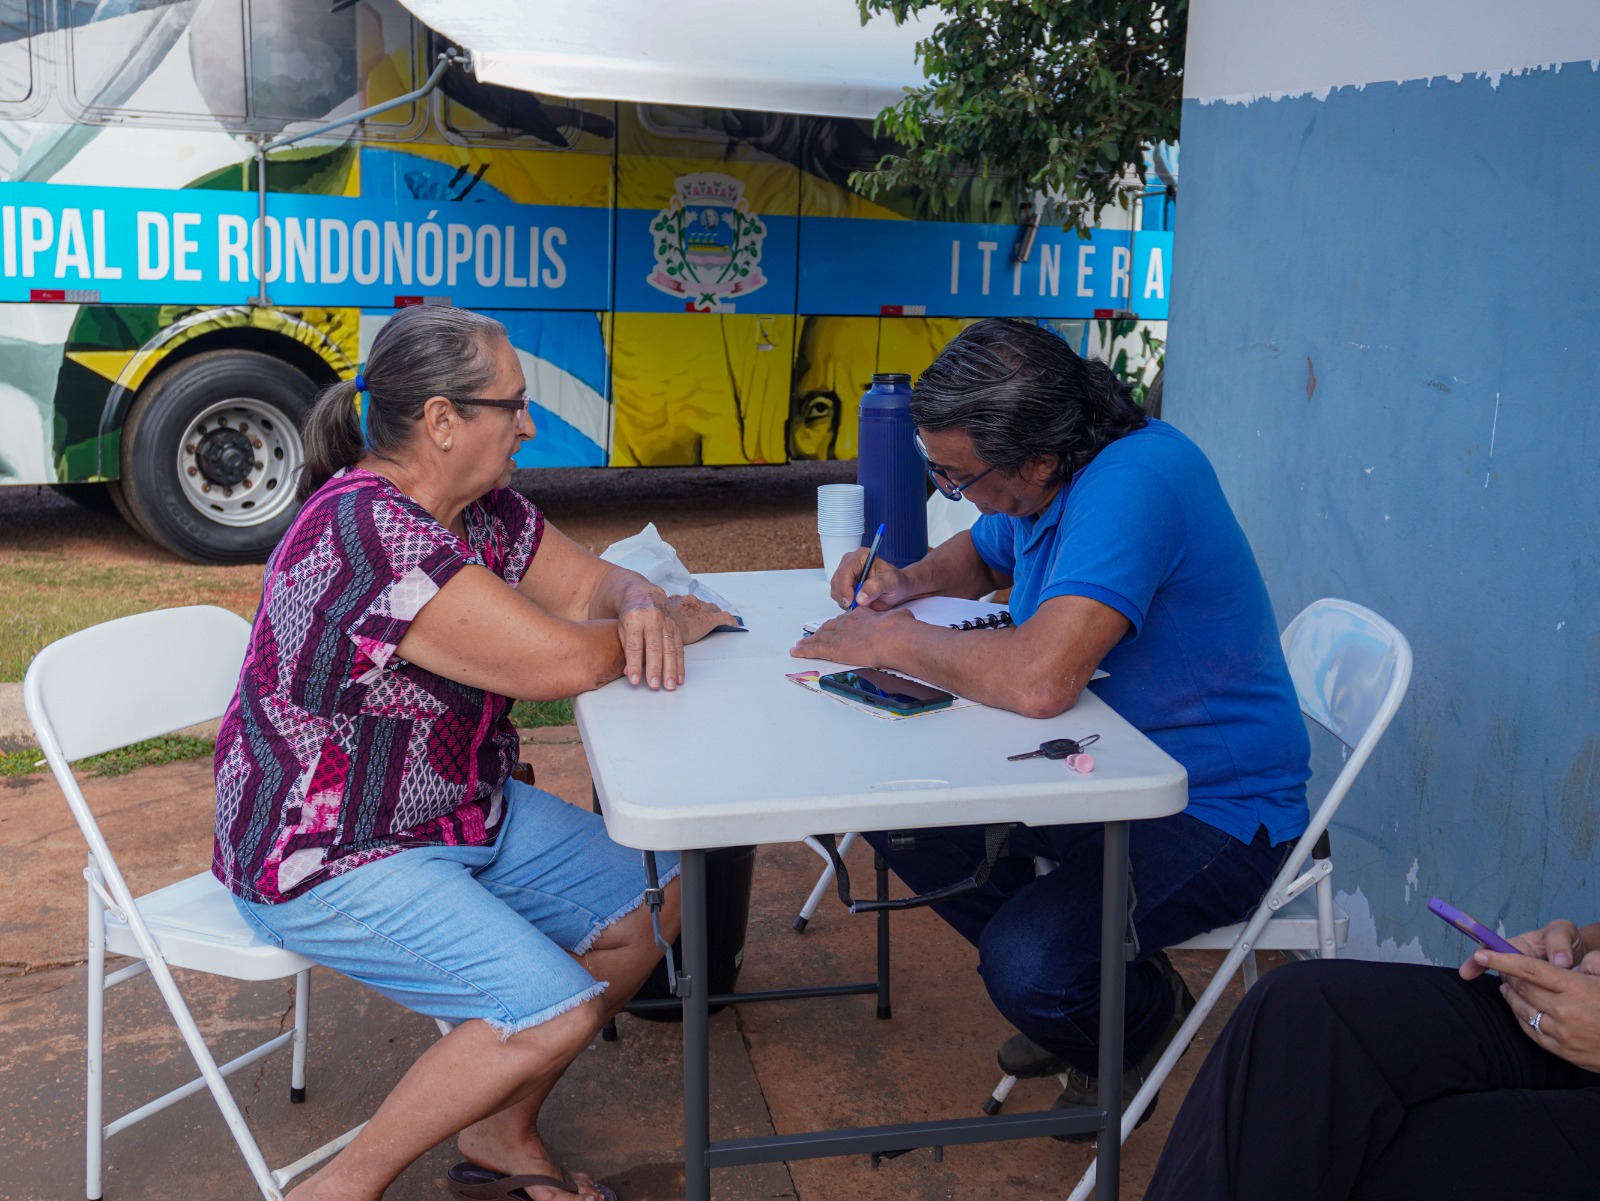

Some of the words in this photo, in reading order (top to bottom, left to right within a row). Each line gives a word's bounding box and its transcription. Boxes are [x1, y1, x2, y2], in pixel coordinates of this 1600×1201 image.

[3, 205, 122, 280] IPAL
[137, 210, 202, 283] DE
[218, 208, 568, 290] RONDONÓPOLIS
